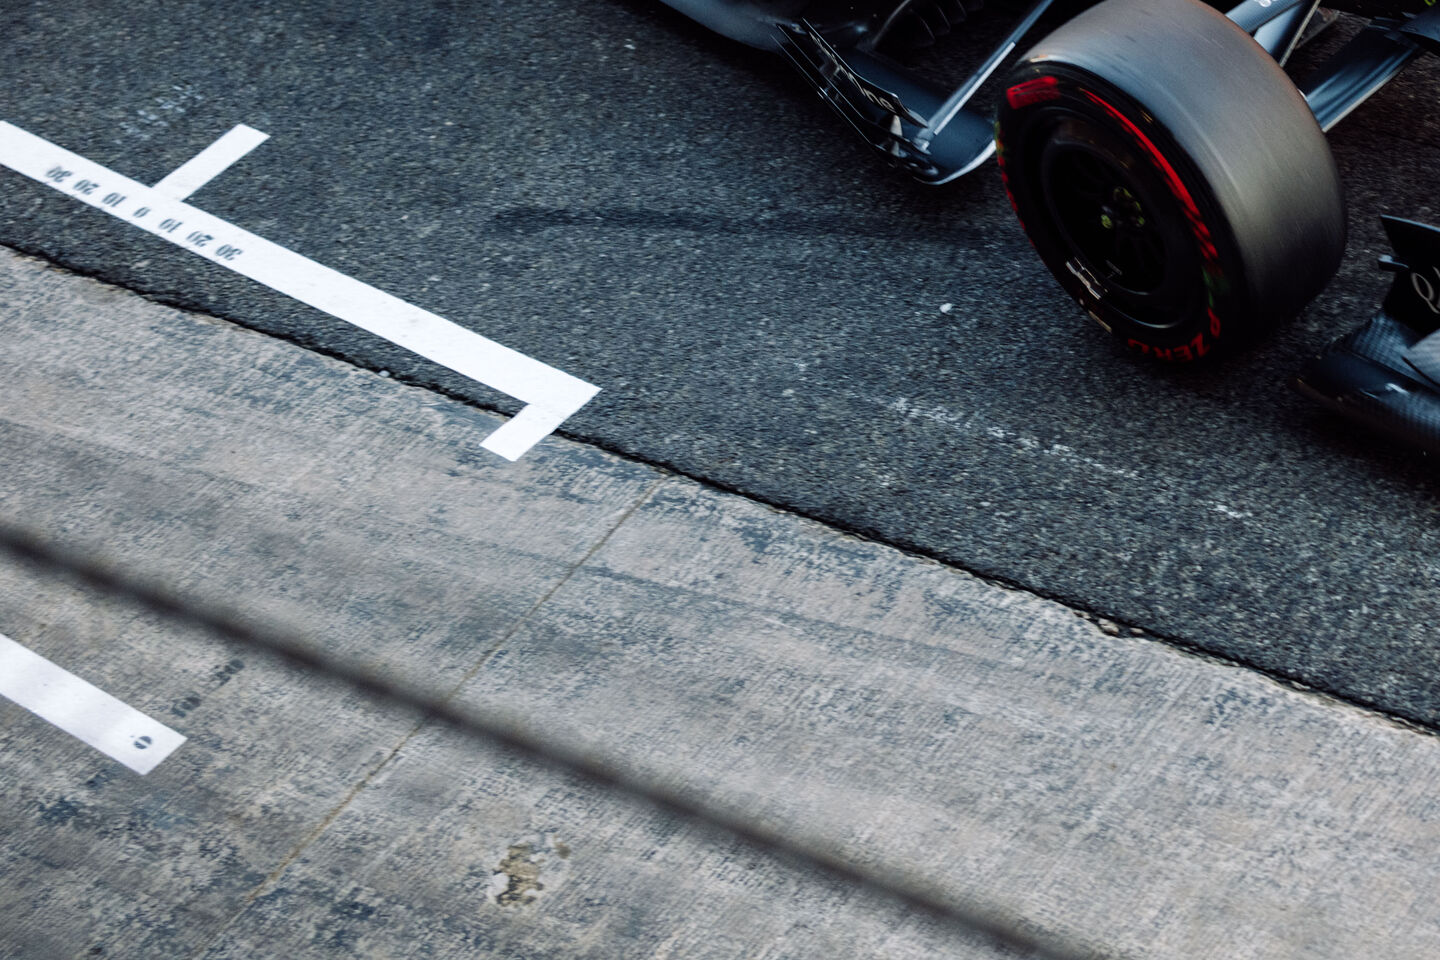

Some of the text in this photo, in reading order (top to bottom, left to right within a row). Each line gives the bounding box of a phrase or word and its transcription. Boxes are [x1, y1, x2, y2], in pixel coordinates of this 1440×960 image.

[72, 179, 100, 196] 20
[101, 192, 127, 208] 10
[157, 218, 184, 233] 10
[185, 230, 215, 247] 20
